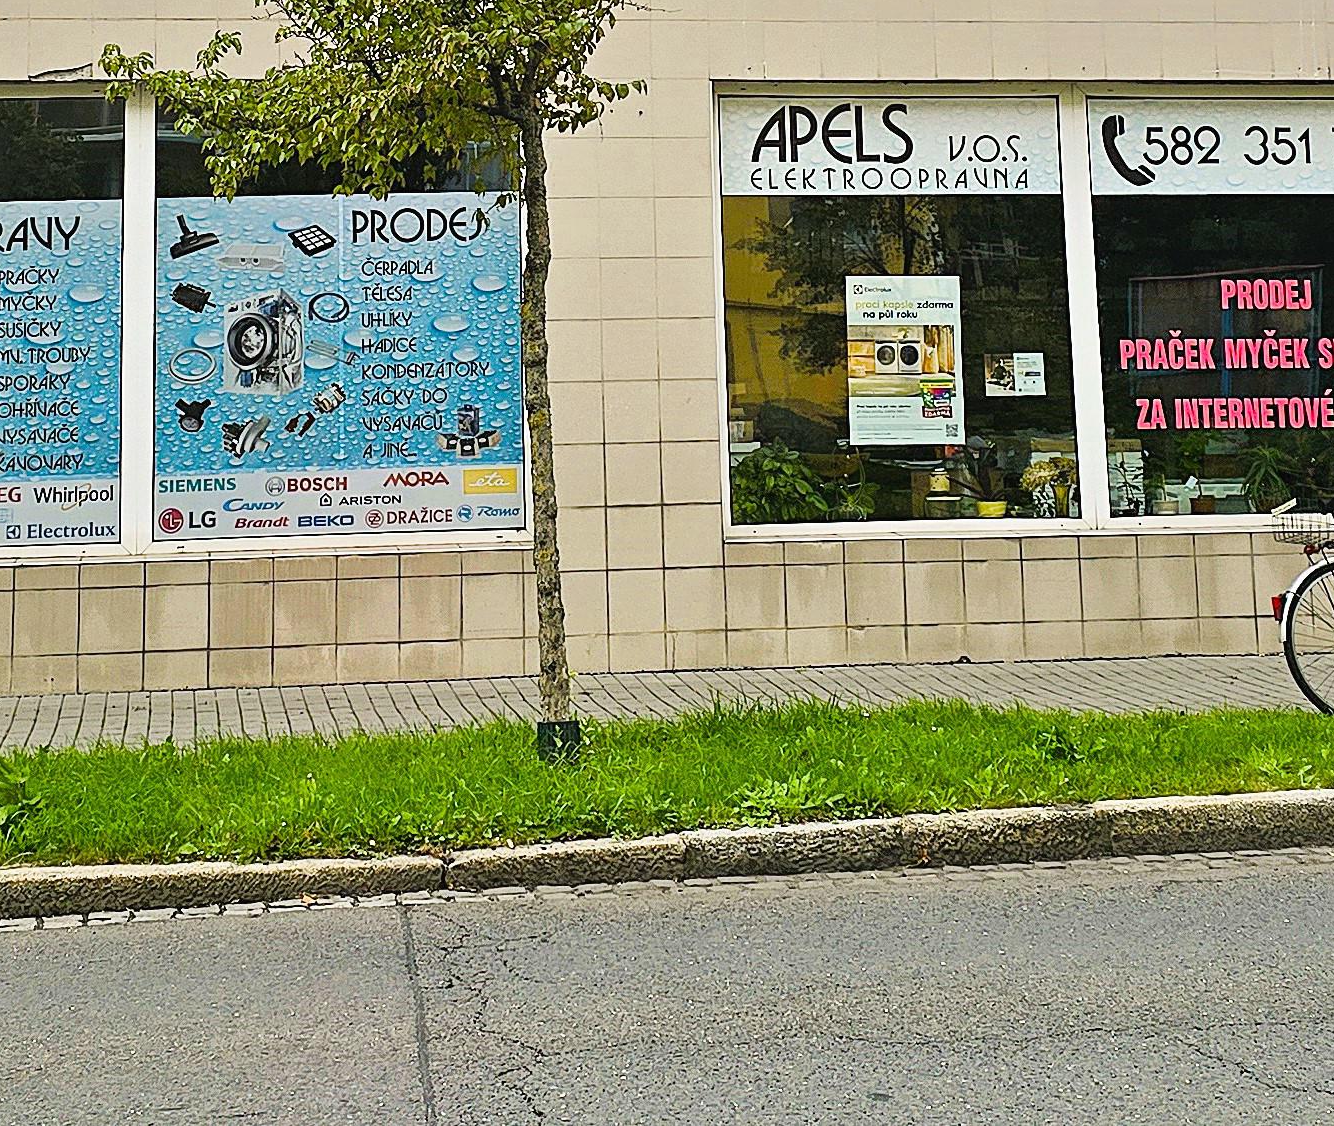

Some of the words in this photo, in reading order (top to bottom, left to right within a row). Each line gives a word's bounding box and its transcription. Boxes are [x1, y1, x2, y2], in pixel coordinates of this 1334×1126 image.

[751, 102, 914, 165] APELS
[1142, 125, 1221, 166] 582
[1243, 125, 1313, 166] 351
[750, 167, 1029, 191] ELEKTROOPRAVNA
[361, 258, 434, 276] ČERPADLA
[362, 282, 413, 301] TĚLESA
[1220, 278, 1313, 311] PRODEJ
[916, 300, 954, 309] zdarma
[361, 309, 413, 328] UHLÍKY
[862, 311, 876, 319] na
[896, 310, 918, 319] roku
[361, 337, 417, 354] HADICE
[1119, 329, 1216, 370] PRAČEK
[1224, 329, 1311, 369] MYČEK
[27, 346, 91, 364] TROUBY
[361, 359, 490, 380] KONDENZÁTORY
[361, 387, 415, 406] SÁČKY
[422, 387, 448, 404] DO
[362, 409, 443, 432] VYSAVAČŮ
[1135, 398, 1168, 430] ZA
[362, 443, 372, 458] A
[158, 477, 237, 493] SIEMENS
[287, 476, 348, 492] BOSCH
[383, 471, 450, 487] MORA
[33, 485, 114, 507] Whirlpool
[338, 495, 402, 506] ARISTON
[189, 511, 217, 529] LG
[386, 507, 453, 524] DRAŽICE
[477, 506, 520, 517] Romo
[27, 522, 116, 539] Electrolux
[234, 516, 290, 529] Brandt
[297, 515, 354, 528] BEKO
